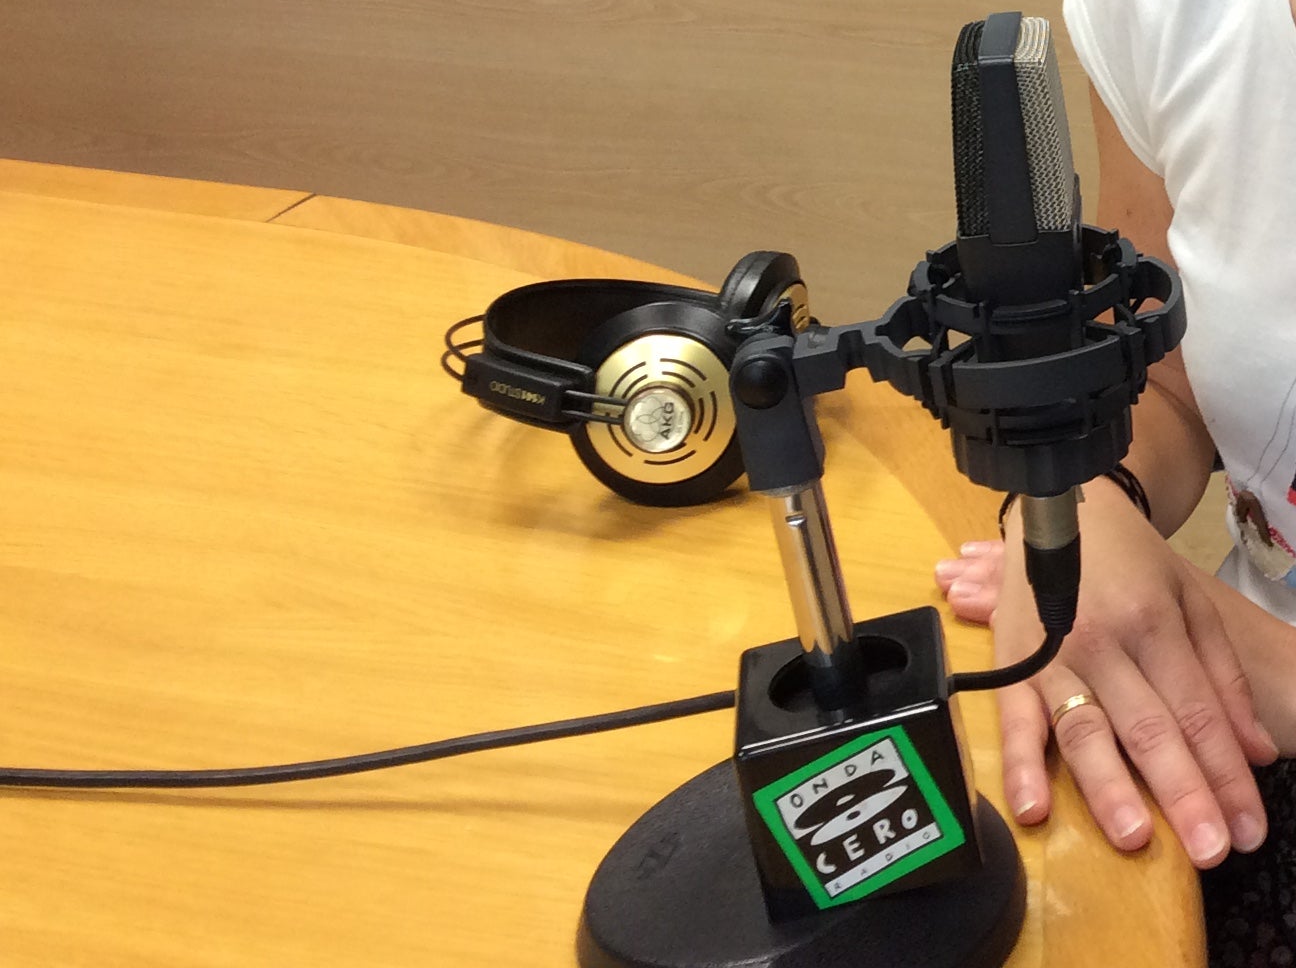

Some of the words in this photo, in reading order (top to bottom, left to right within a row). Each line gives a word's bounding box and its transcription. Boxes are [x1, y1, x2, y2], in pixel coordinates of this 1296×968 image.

[660, 402, 674, 440] AKG
[790, 750, 885, 809] ONDA
[816, 808, 919, 874] CERO
